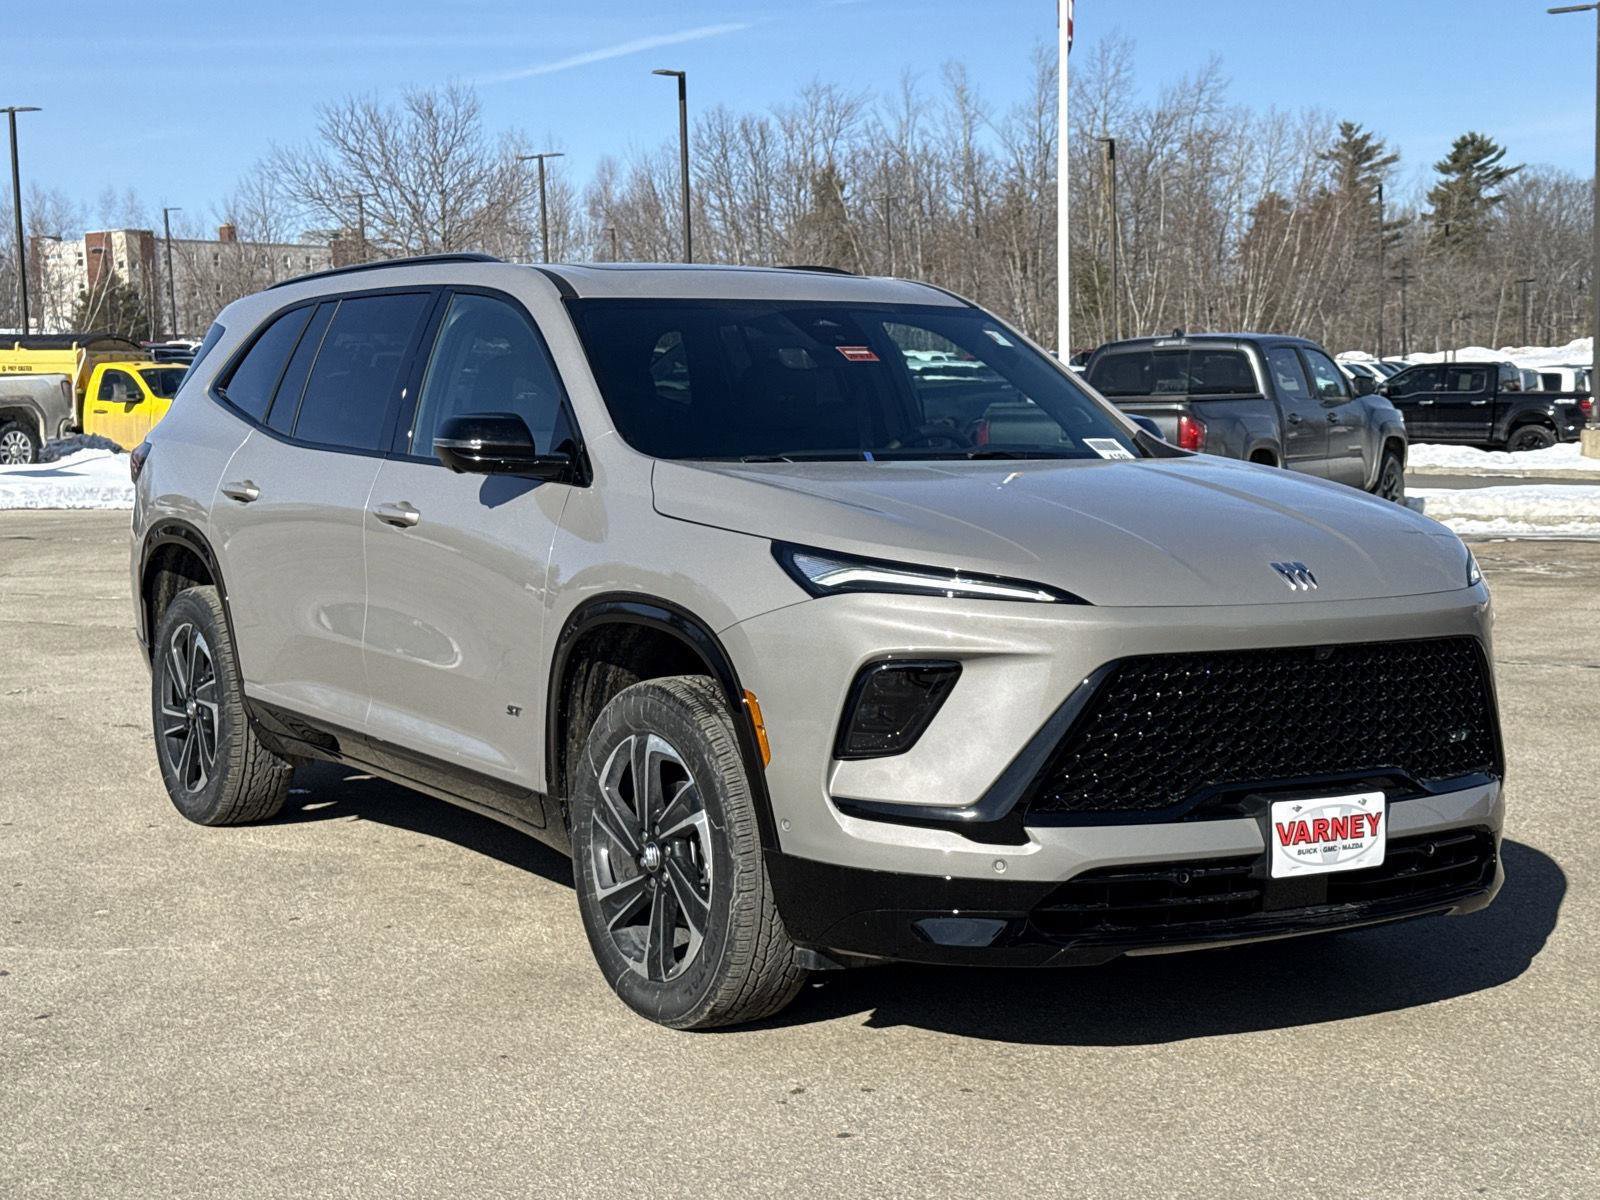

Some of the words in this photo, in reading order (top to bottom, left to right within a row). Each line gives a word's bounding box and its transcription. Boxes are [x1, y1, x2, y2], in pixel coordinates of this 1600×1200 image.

[505, 704, 522, 717] ST
[1275, 812, 1382, 846] VARNEY
[1322, 845, 1338, 853] GMC
[1341, 842, 1363, 850] MAZDA
